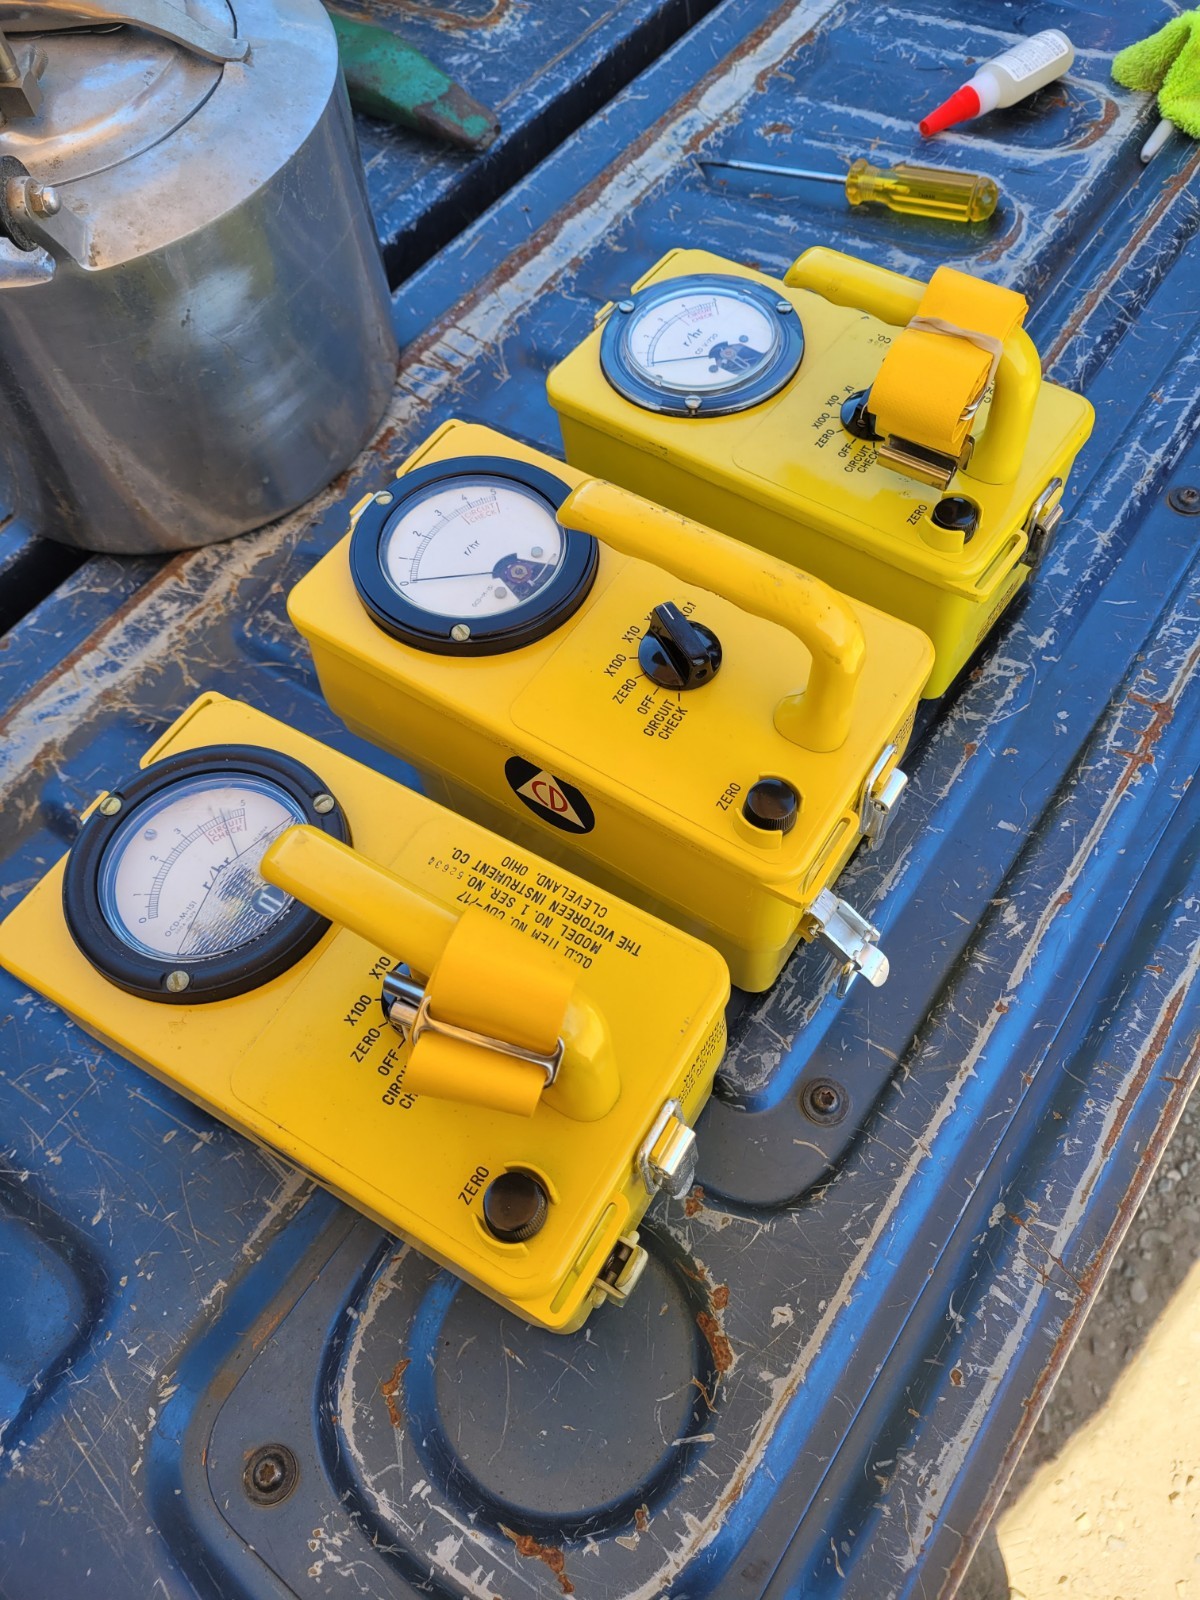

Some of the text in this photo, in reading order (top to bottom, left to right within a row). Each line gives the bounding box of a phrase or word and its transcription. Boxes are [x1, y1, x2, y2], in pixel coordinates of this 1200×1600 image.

[682, 328, 703, 347] r/hr
[878, 334, 891, 344] CO.
[812, 412, 830, 430] X100
[815, 429, 835, 448] ZERO
[838, 443, 852, 457] OFF
[844, 445, 871, 472] CIRCUIT
[857, 450, 880, 473] CHECK
[465, 502, 495, 519] CIRCUIT
[469, 509, 497, 524] CHECK
[906, 504, 928, 525] ZERO
[464, 539, 480, 556] r/hr
[622, 626, 640, 643] X10
[604, 654, 626, 677] X100
[612, 678, 637, 704] ZERO
[637, 695, 655, 715] OFF
[643, 699, 675, 737] CIRCUIT
[658, 706, 688, 740] CHECK
[531, 781, 568, 812] CD
[716, 782, 741, 811] ZERO
[208, 818, 244, 836] CIRCUIT
[211, 825, 243, 842] CHECK
[202, 856, 231, 890] r/hr
[501, 856, 529, 876] OHIO
[468, 874, 486, 892] NO.
[452, 847, 642, 956] THE VICTOREEN INSTRUMENT CO.
[491, 886, 516, 908] SER.
[520, 904, 530, 915] 1
[535, 910, 553, 929] NO.
[562, 924, 602, 954] MODEL
[369, 956, 391, 980] X10
[344, 994, 372, 1026] X100
[350, 1028, 380, 1063] ZERO
[378, 1049, 399, 1076] OFF
[458, 1166, 489, 1205] ZERO
